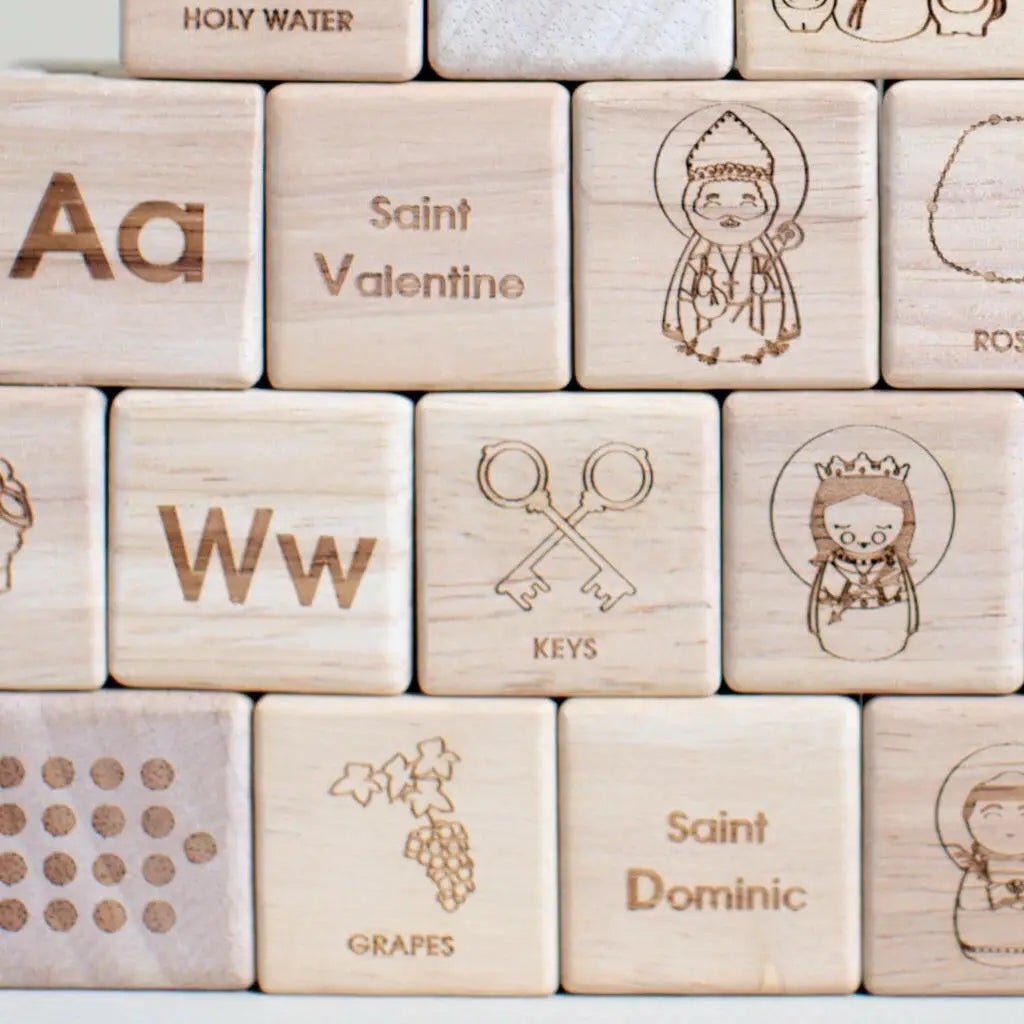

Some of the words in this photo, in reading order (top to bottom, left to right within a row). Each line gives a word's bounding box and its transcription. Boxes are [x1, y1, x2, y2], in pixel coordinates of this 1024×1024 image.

[183, 7, 255, 32] HOLY
[262, 8, 354, 32] WATER
[9, 172, 206, 283] Aa
[370, 195, 472, 232] Saint
[314, 252, 526, 300] Valentine
[157, 504, 378, 609] Ww
[532, 636, 599, 661] KEYS
[667, 810, 769, 845] Saint
[626, 868, 807, 913] Dominic
[347, 934, 455, 958] GRAPES
